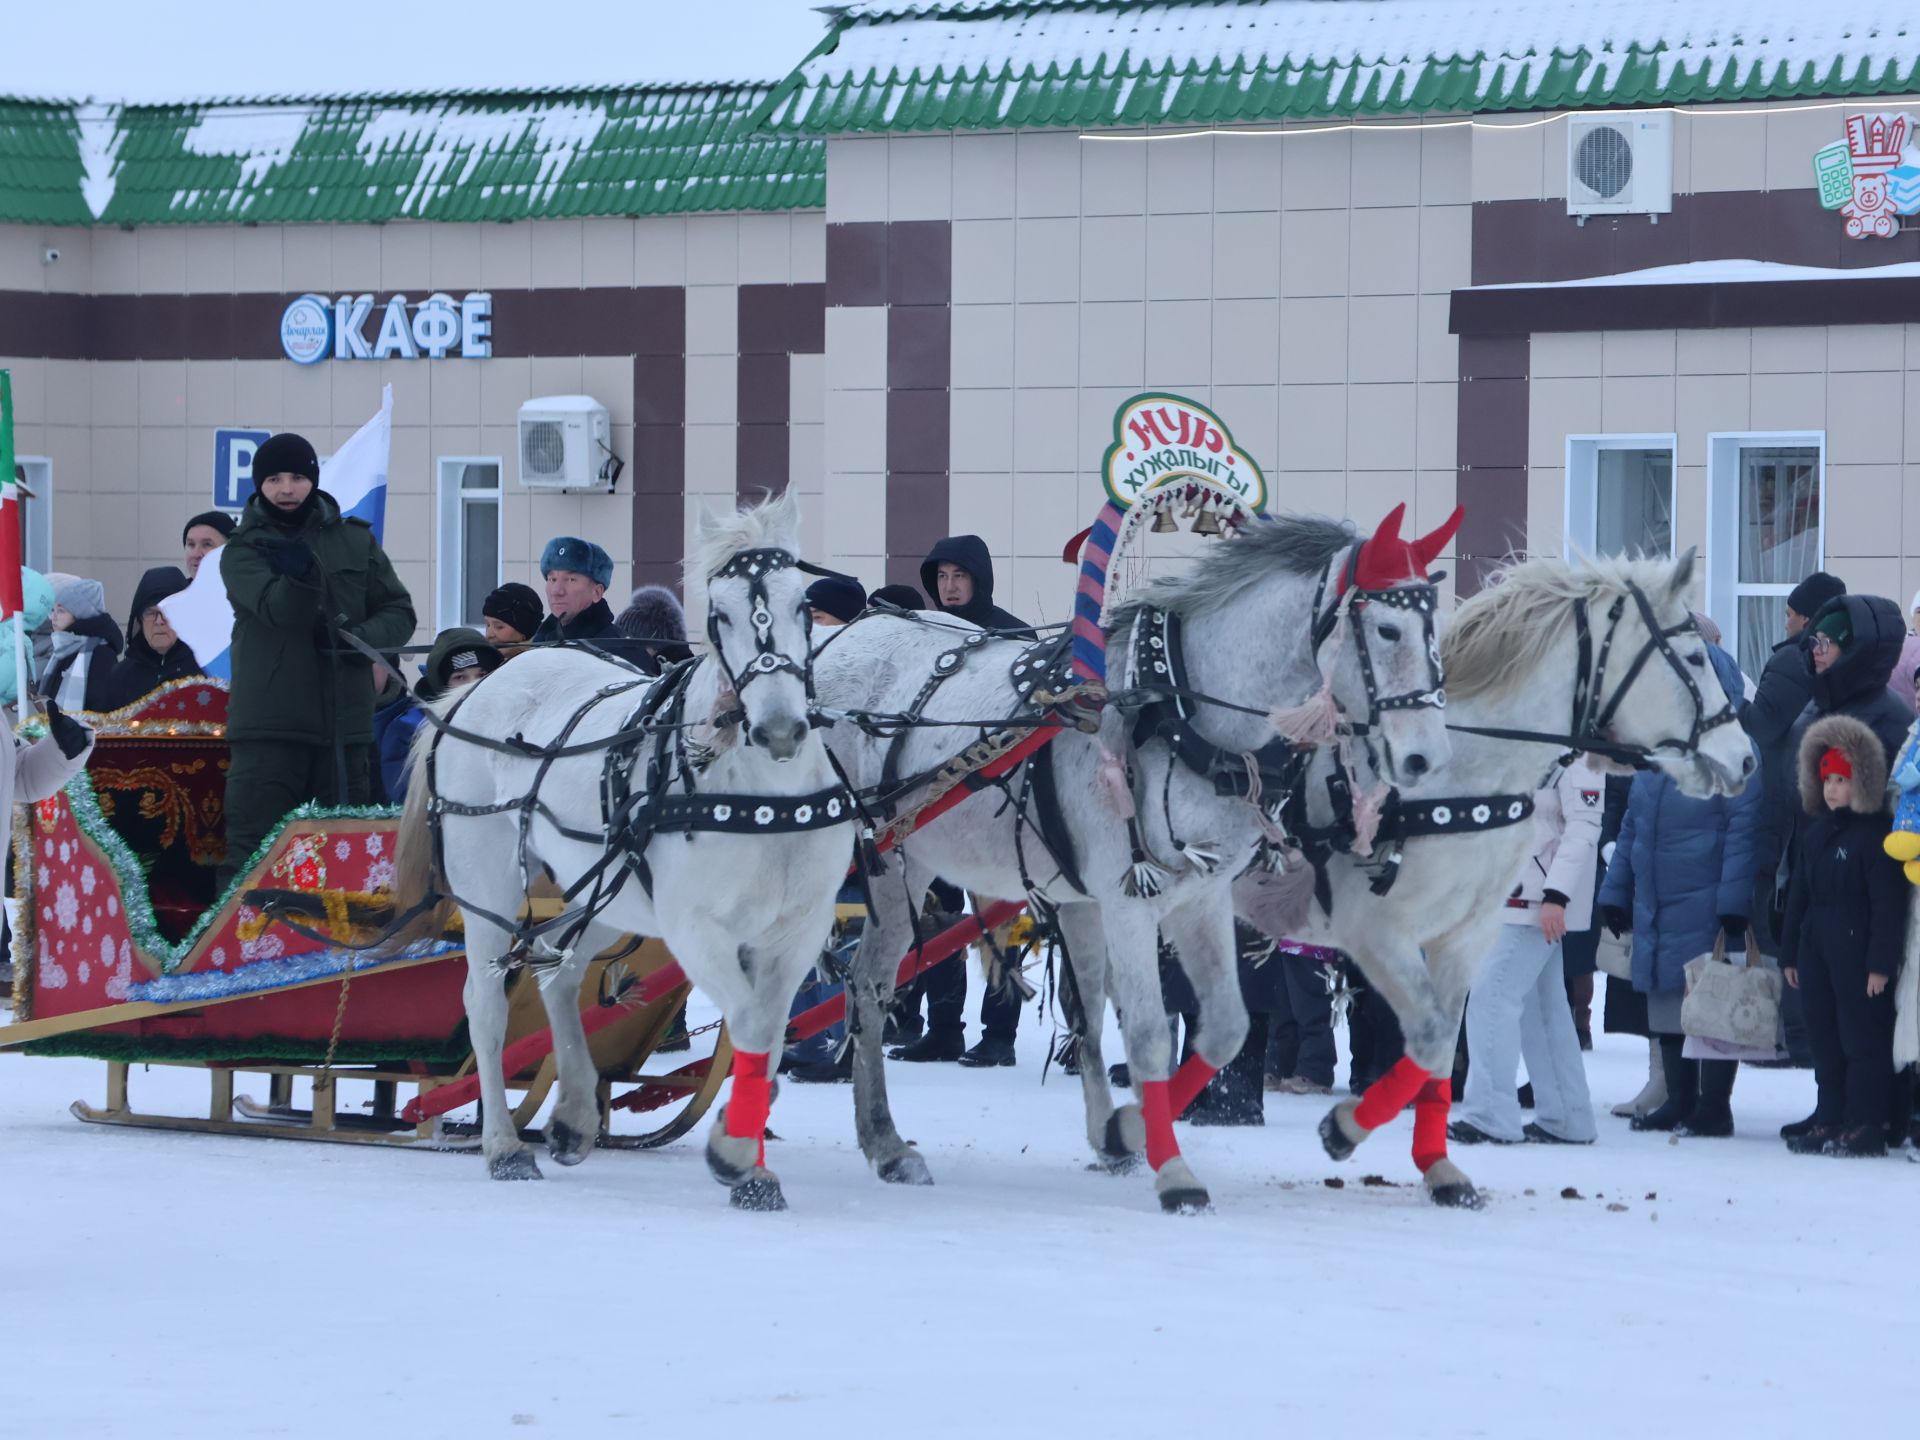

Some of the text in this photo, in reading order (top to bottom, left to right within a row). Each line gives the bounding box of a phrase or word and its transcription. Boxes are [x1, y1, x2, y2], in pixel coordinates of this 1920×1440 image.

[335, 298, 491, 359] КАФЕ
[1128, 406, 1223, 453] НУР
[228, 438, 258, 501] P
